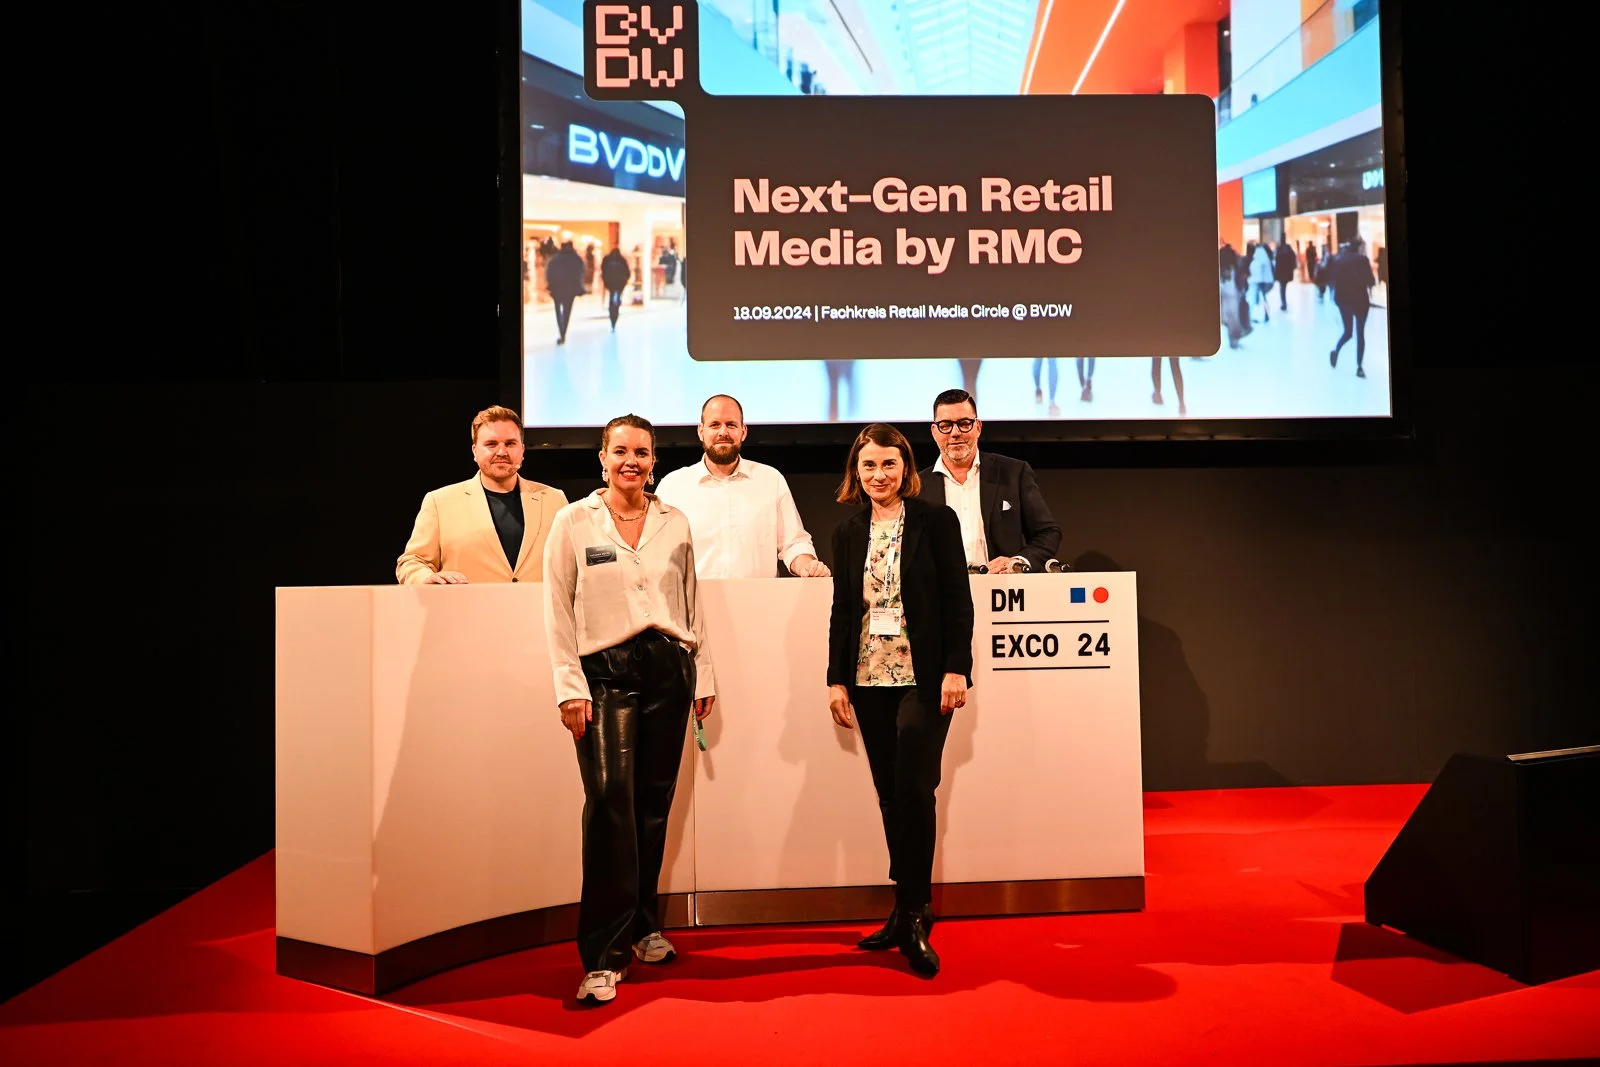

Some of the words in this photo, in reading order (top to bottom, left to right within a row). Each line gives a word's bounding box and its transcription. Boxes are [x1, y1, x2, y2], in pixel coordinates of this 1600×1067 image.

[595, 5, 683, 45] BV
[596, 48, 684, 88] DW
[733, 177, 968, 214] Next-Gen
[981, 175, 1113, 212] Retail
[734, 228, 883, 267] Media
[896, 228, 956, 275] by
[968, 228, 1083, 265] RMC
[733, 305, 812, 321] 18.09.2024
[821, 305, 887, 320] Fachkreis
[888, 304, 926, 319] Retail
[928, 304, 969, 319] Media
[970, 303, 1010, 319] Circle
[1011, 303, 1028, 321] @
[1029, 303, 1073, 318] BVDW
[991, 588, 1025, 612] DM
[991, 633, 1059, 658] EXCO
[1077, 632, 1111, 657] 24
